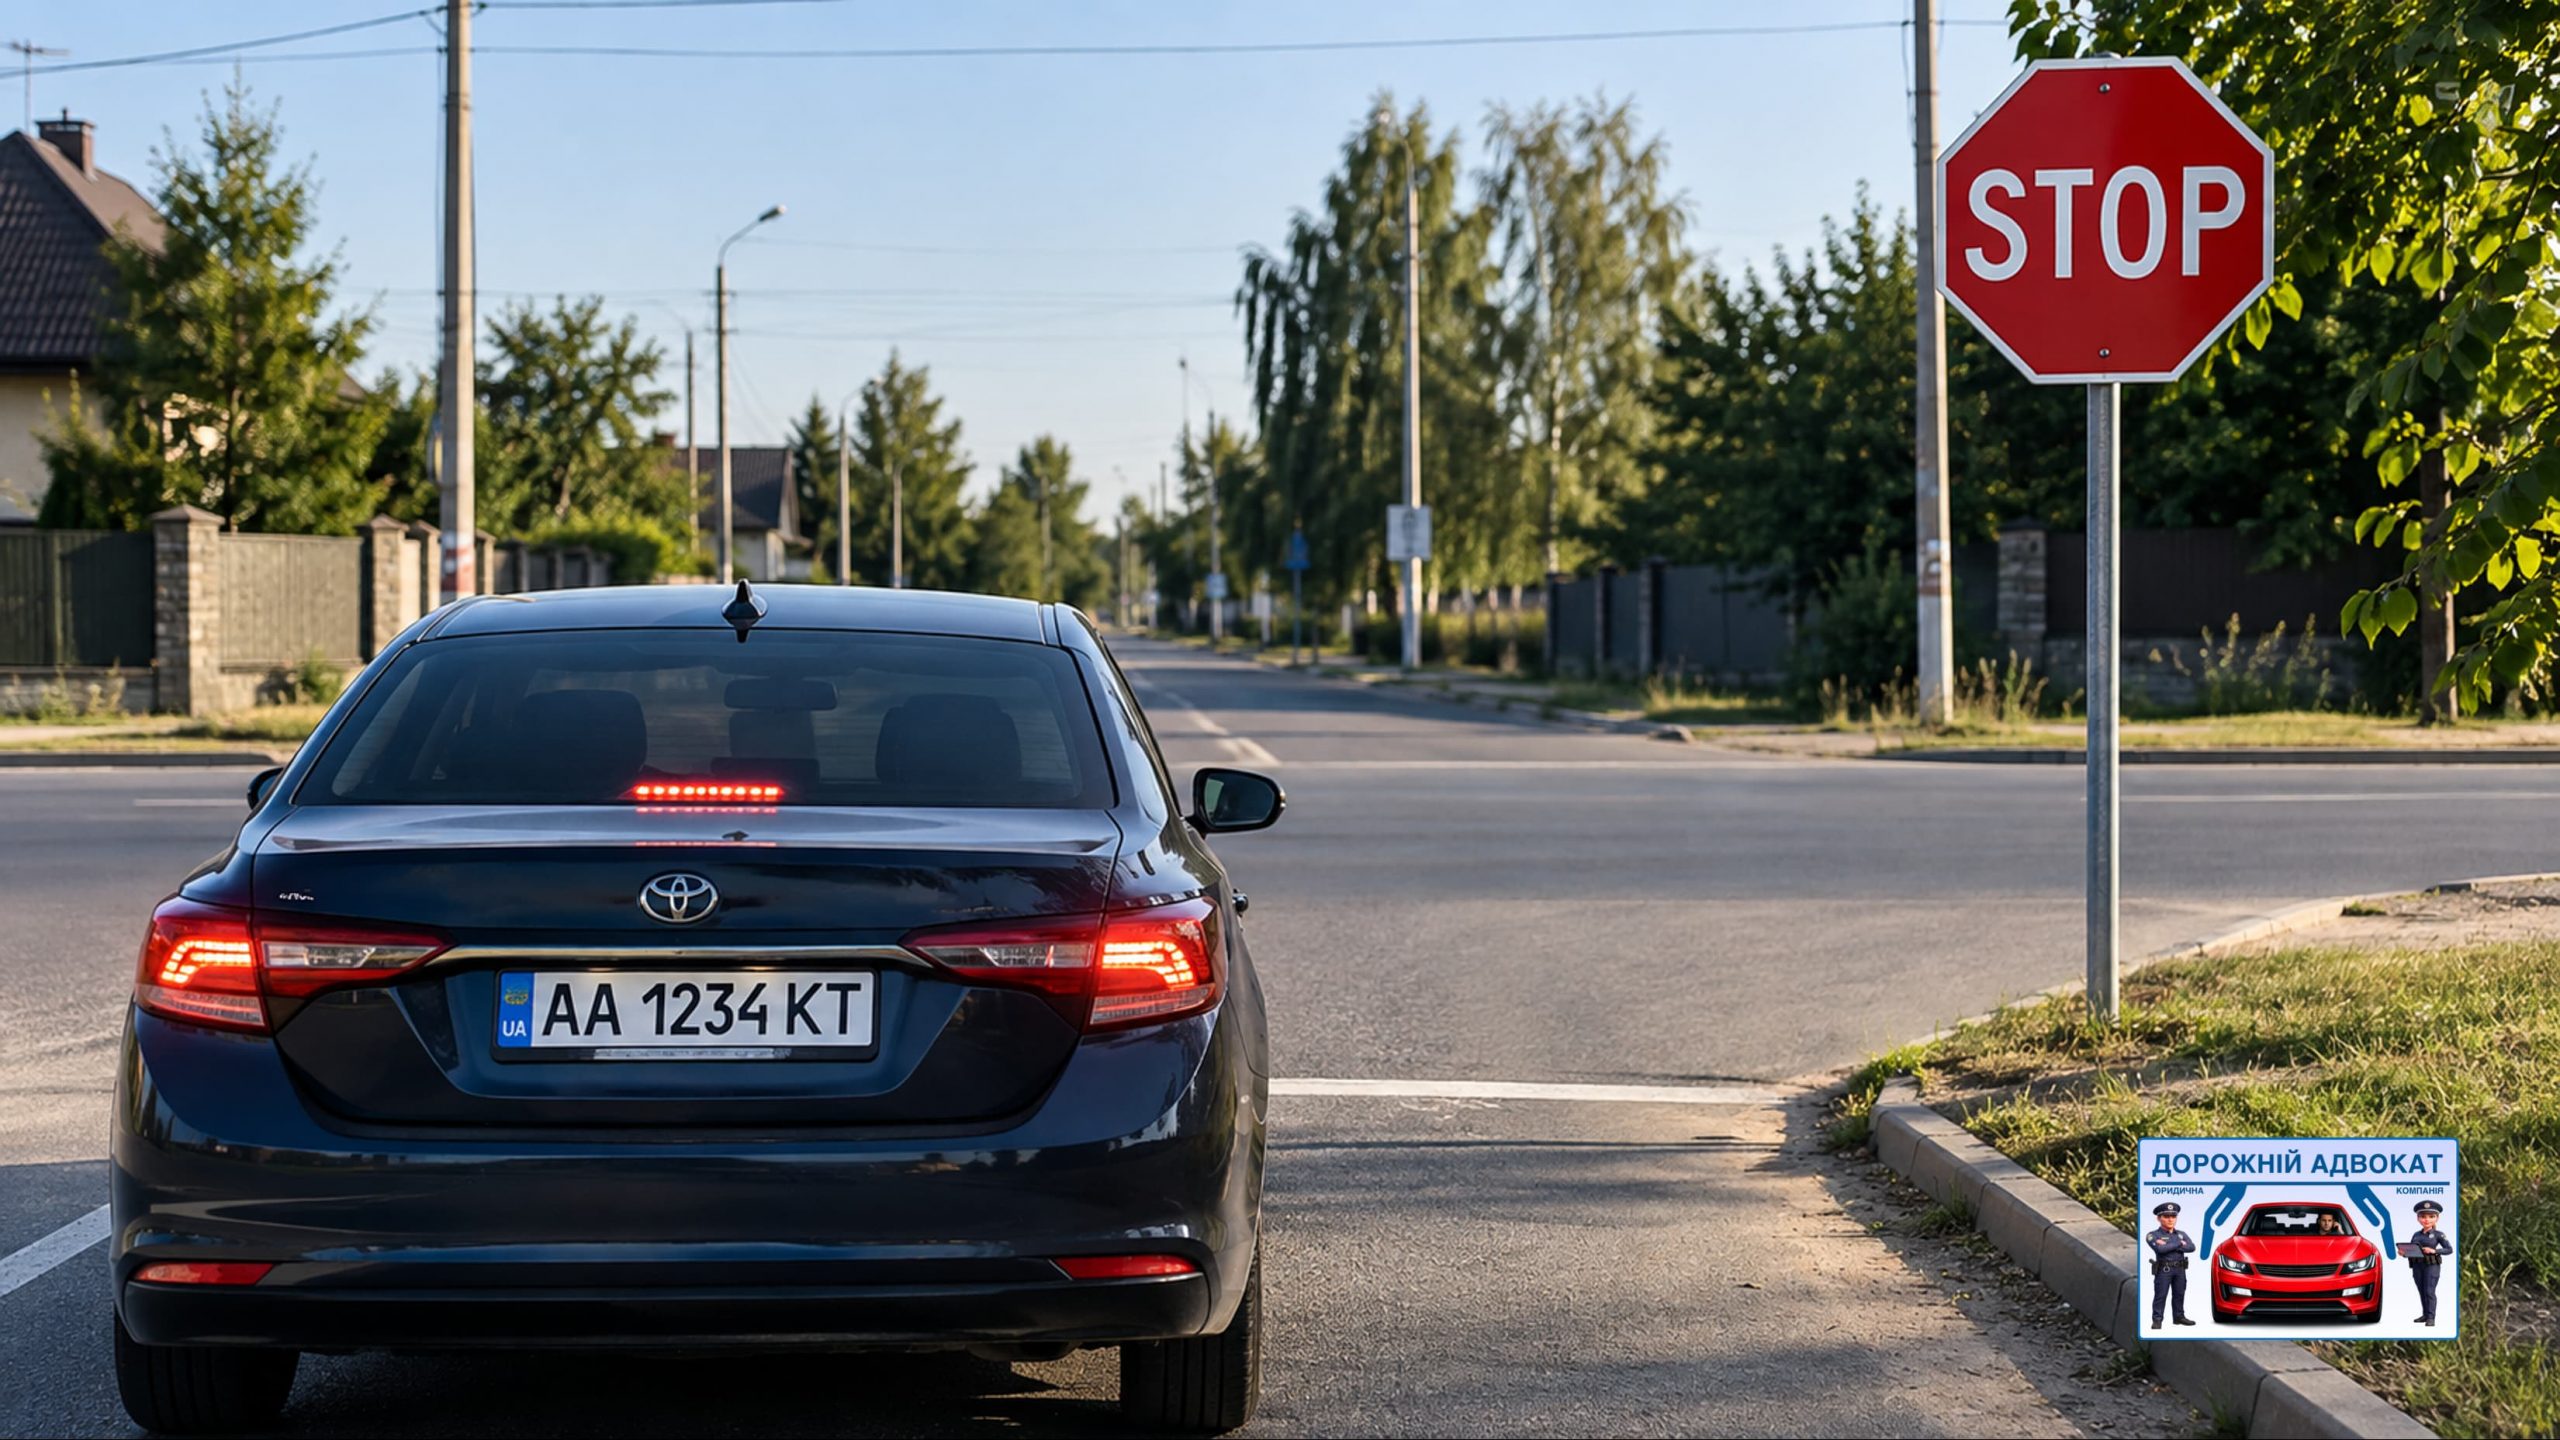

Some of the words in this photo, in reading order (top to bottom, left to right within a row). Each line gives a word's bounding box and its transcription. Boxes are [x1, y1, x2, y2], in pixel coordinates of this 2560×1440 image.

[1965, 165, 2246, 281] STOP
[502, 1020, 527, 1037] UA
[542, 982, 622, 1036] AA
[642, 982, 768, 1036] 1234
[786, 982, 862, 1036] KT
